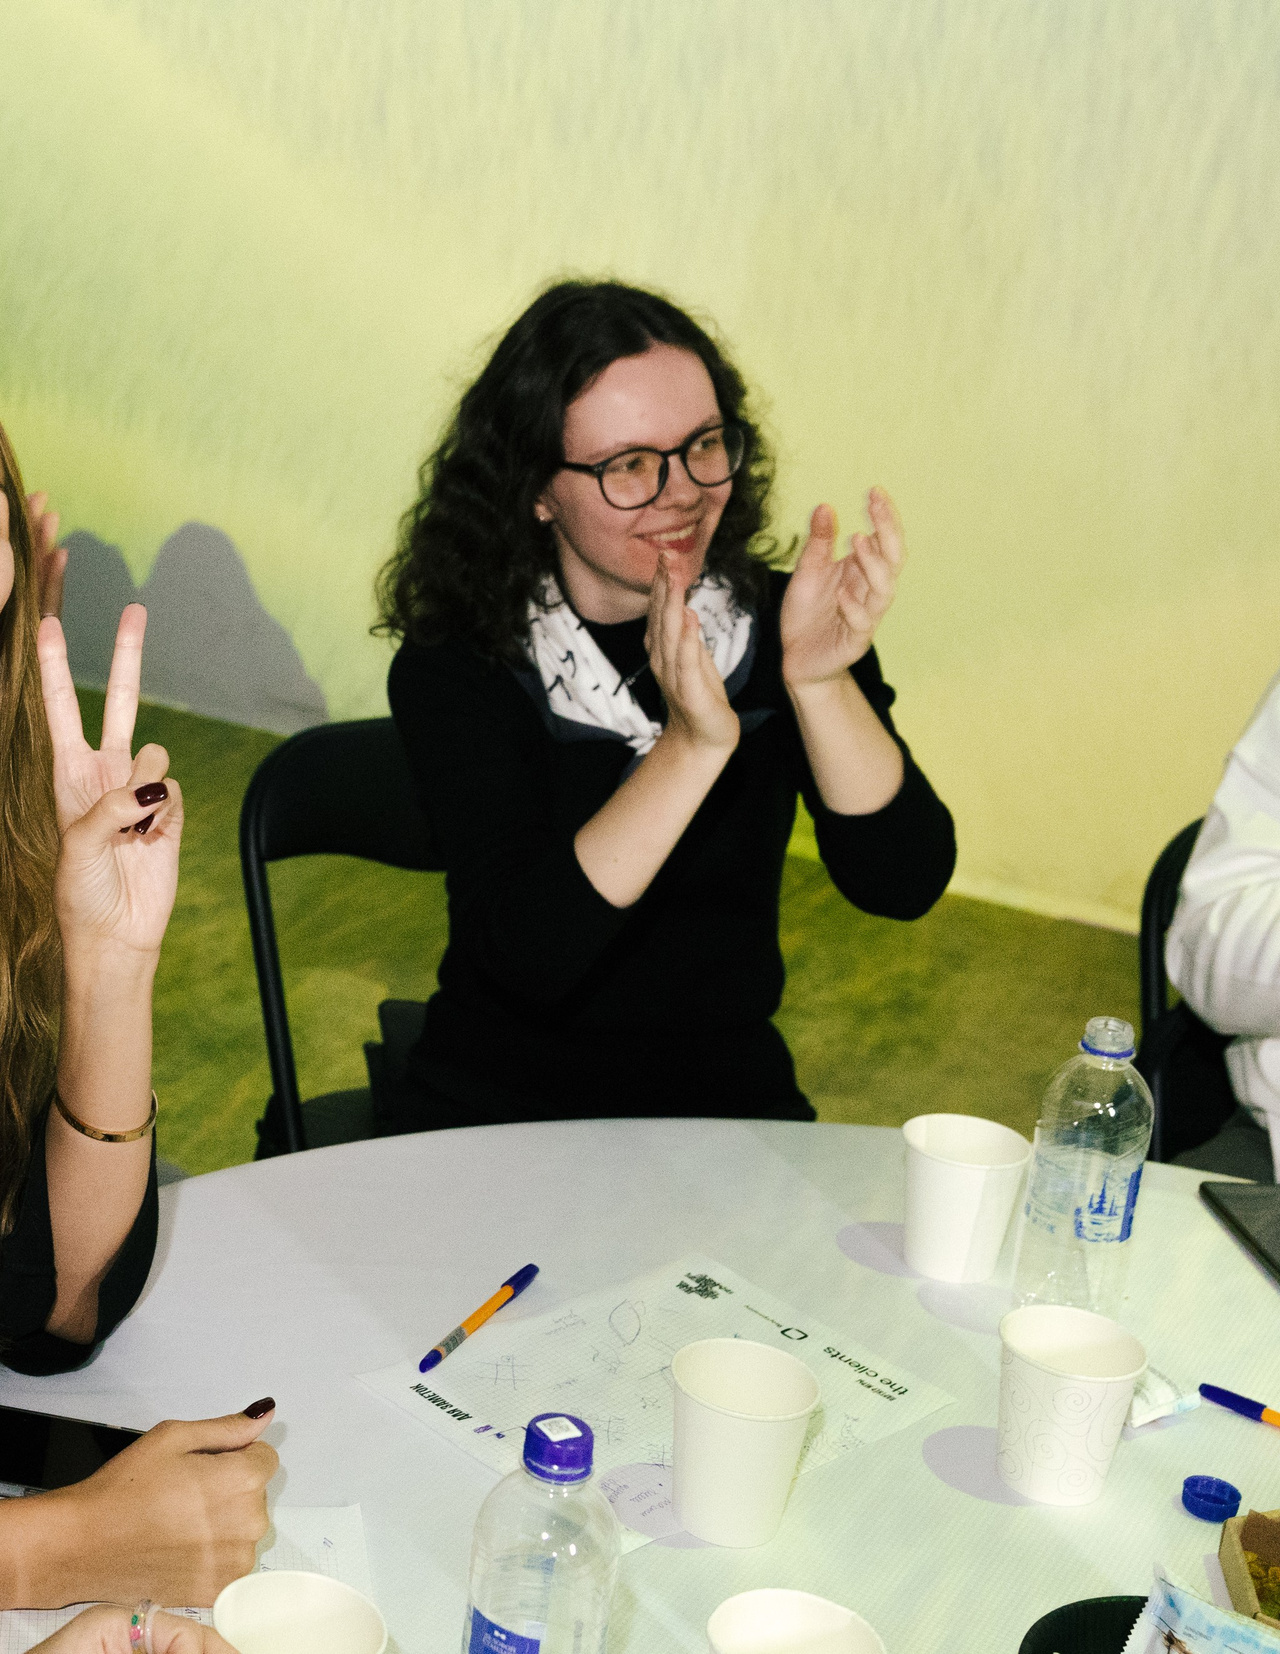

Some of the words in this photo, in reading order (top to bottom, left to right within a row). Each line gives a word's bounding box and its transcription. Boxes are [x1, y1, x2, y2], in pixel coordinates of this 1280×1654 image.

[824, 1346, 878, 1377] clients
[409, 1383, 454, 1410] ЗАМЕТОК
[880, 1378, 908, 1395] the
[446, 1407, 473, 1421] ДЛЯ
